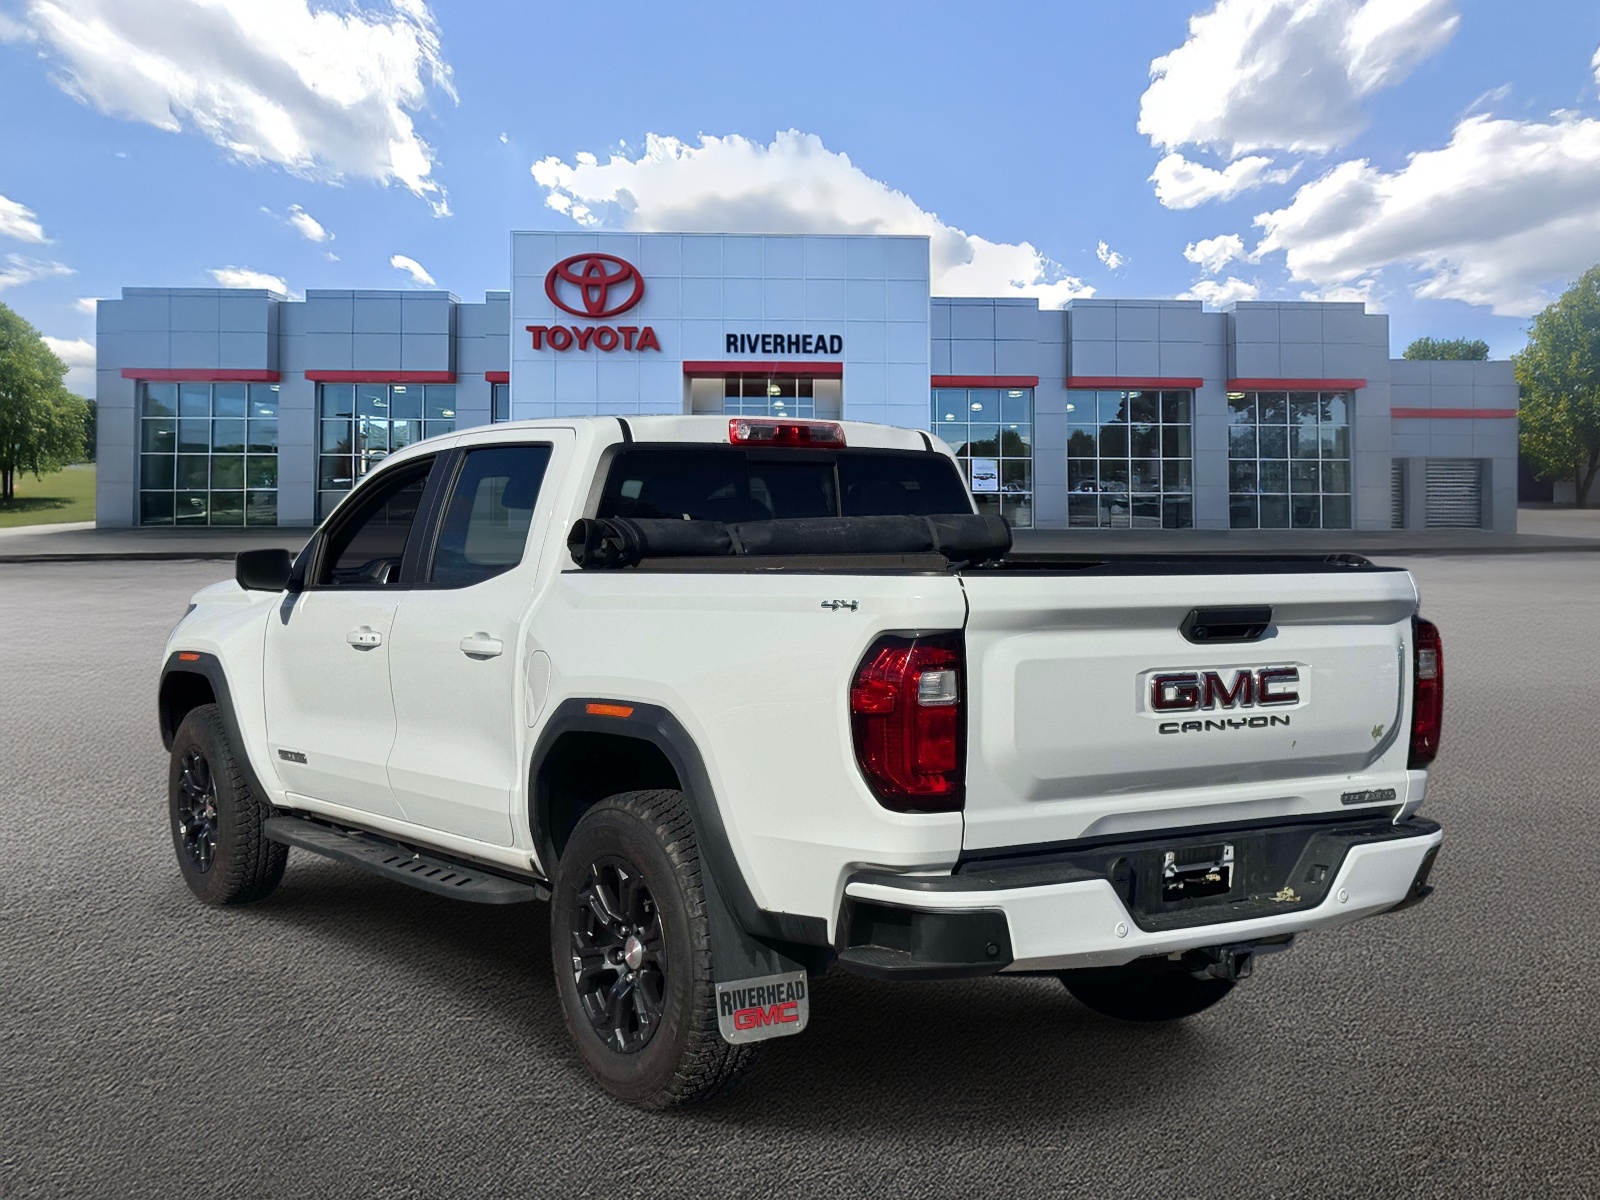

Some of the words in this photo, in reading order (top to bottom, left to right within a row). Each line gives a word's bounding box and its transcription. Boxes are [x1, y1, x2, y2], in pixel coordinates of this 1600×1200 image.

[526, 326, 660, 352] TOYOTA
[726, 334, 843, 355] RIVERHEAD
[1150, 667, 1300, 713] GMC
[1159, 715, 1290, 734] CANYON
[719, 980, 805, 1017] RIVERHEAD
[733, 1001, 799, 1031] GMC
